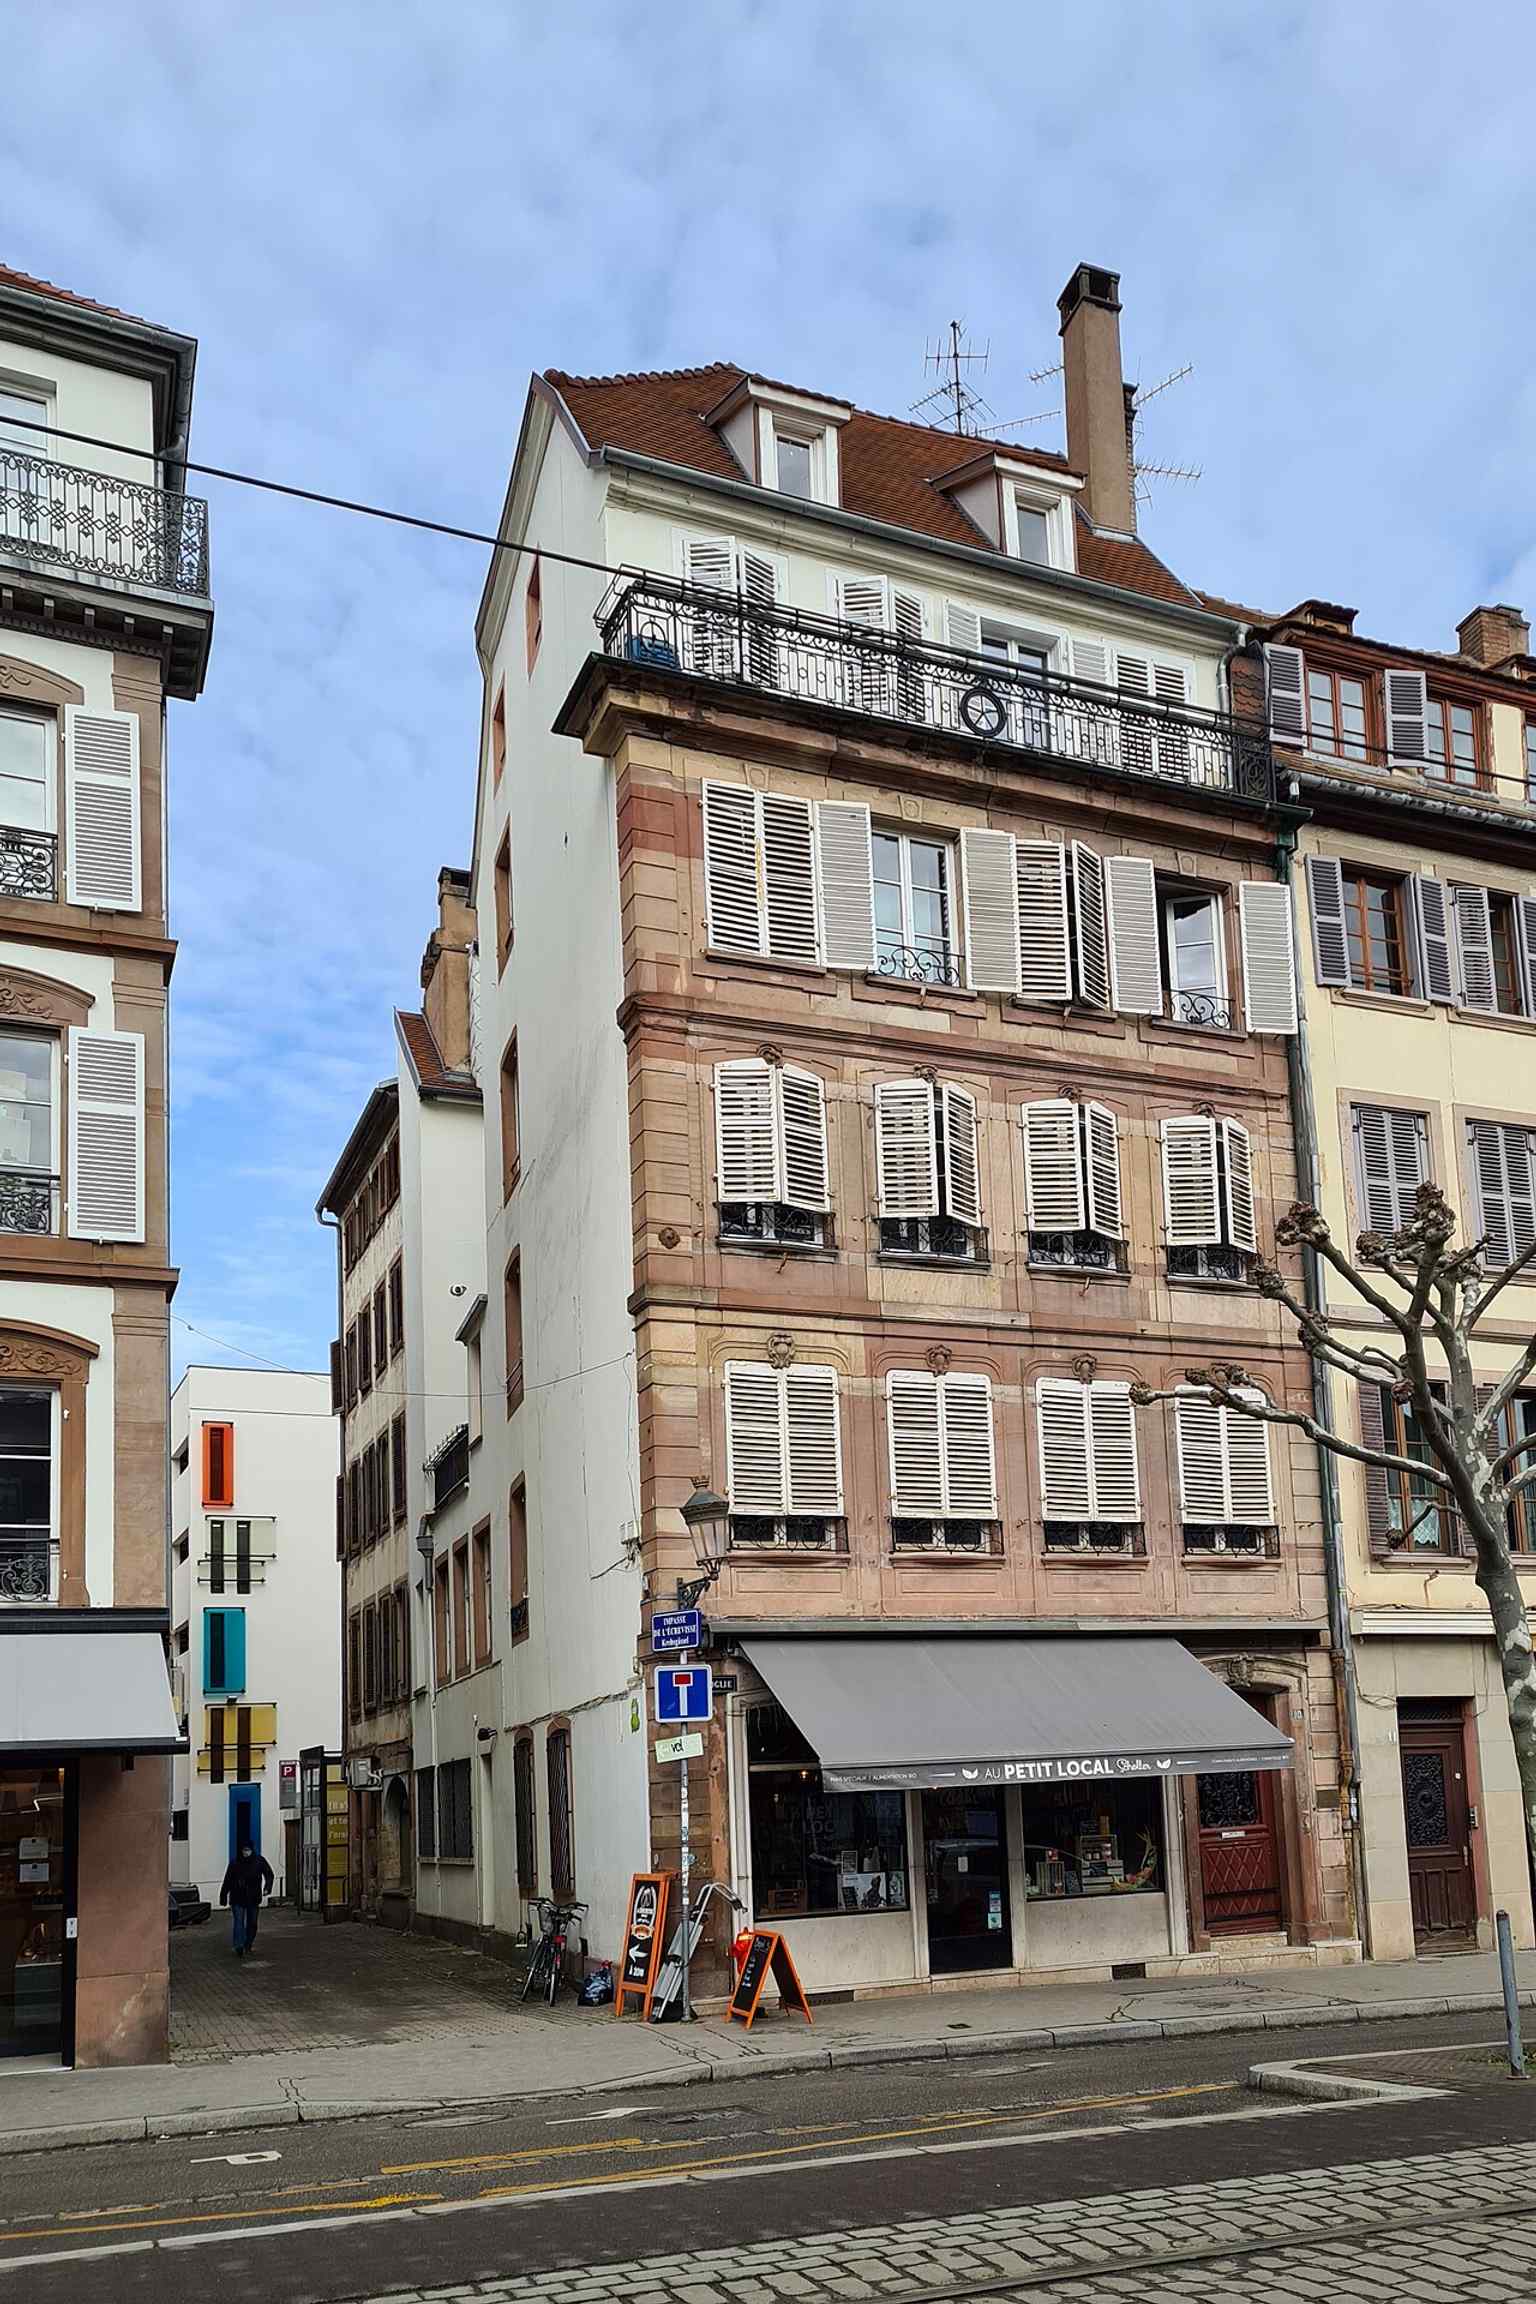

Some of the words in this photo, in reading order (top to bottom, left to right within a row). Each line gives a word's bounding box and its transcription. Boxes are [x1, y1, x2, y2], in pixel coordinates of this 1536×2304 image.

[663, 1615, 687, 1626] IMPASSE
[284, 1766, 293, 1777] P
[985, 1767, 1001, 1780] AU
[1004, 1761, 1053, 1780] PETIT
[1056, 1759, 1114, 1777] LOCAL
